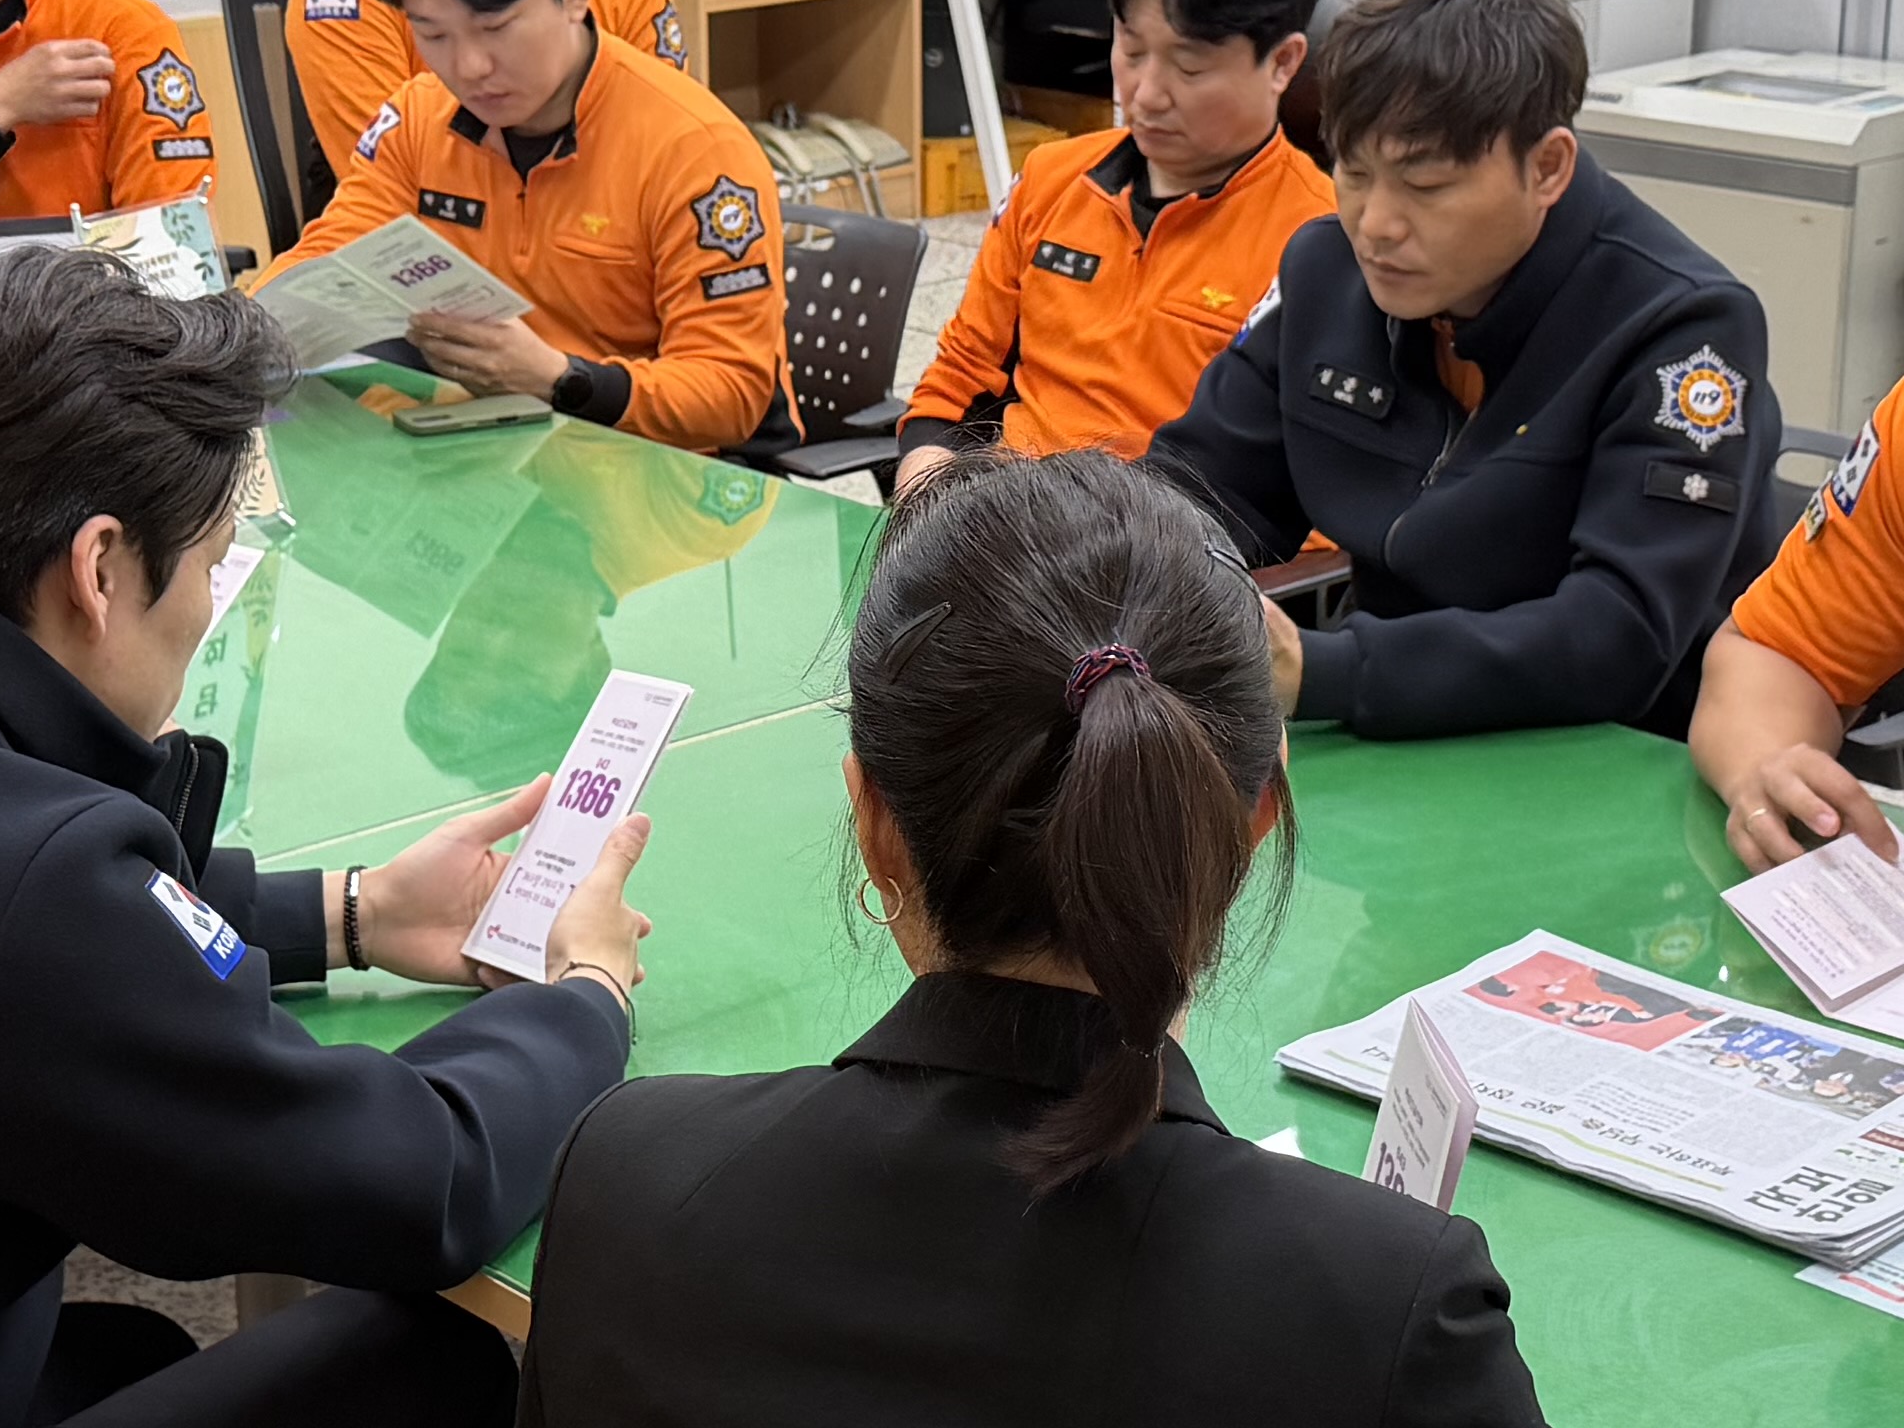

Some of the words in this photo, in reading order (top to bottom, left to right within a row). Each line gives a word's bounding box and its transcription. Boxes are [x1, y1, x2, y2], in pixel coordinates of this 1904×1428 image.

[391, 253, 451, 289] 1366
[1692, 389, 1719, 406] 119
[557, 768, 621, 819] 1366
[212, 921, 241, 960] KOR
